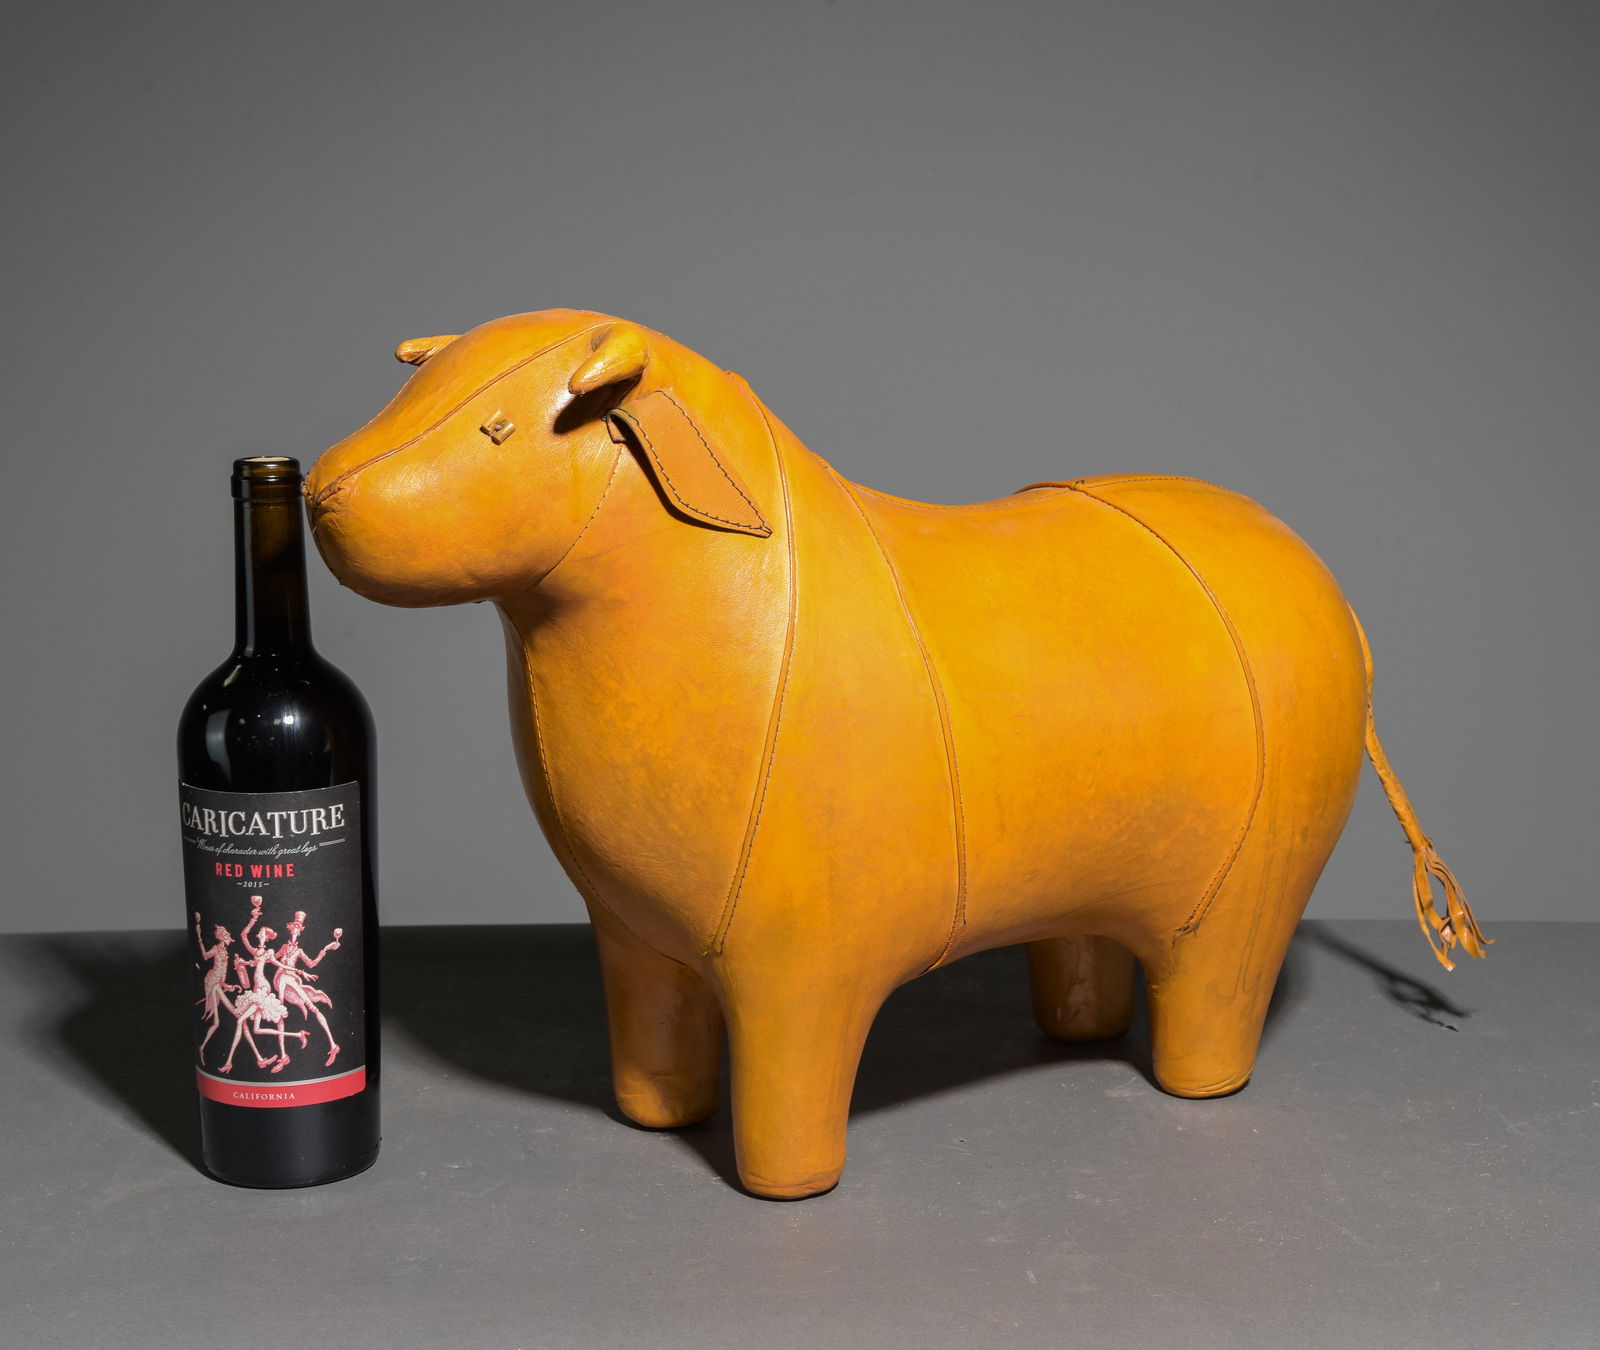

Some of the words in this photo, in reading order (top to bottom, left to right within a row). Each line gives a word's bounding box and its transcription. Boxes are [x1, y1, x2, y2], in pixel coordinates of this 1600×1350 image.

[183, 802, 345, 838] CARICATURE
[197, 838, 215, 851] Wines
[215, 843, 224, 856] of
[223, 843, 257, 855] character
[258, 843, 278, 855] with
[276, 845, 300, 859] great
[300, 841, 318, 856] legs
[215, 862, 243, 877] RED
[251, 863, 295, 878] WINE
[233, 1091, 296, 1100] CALIFORNIA
